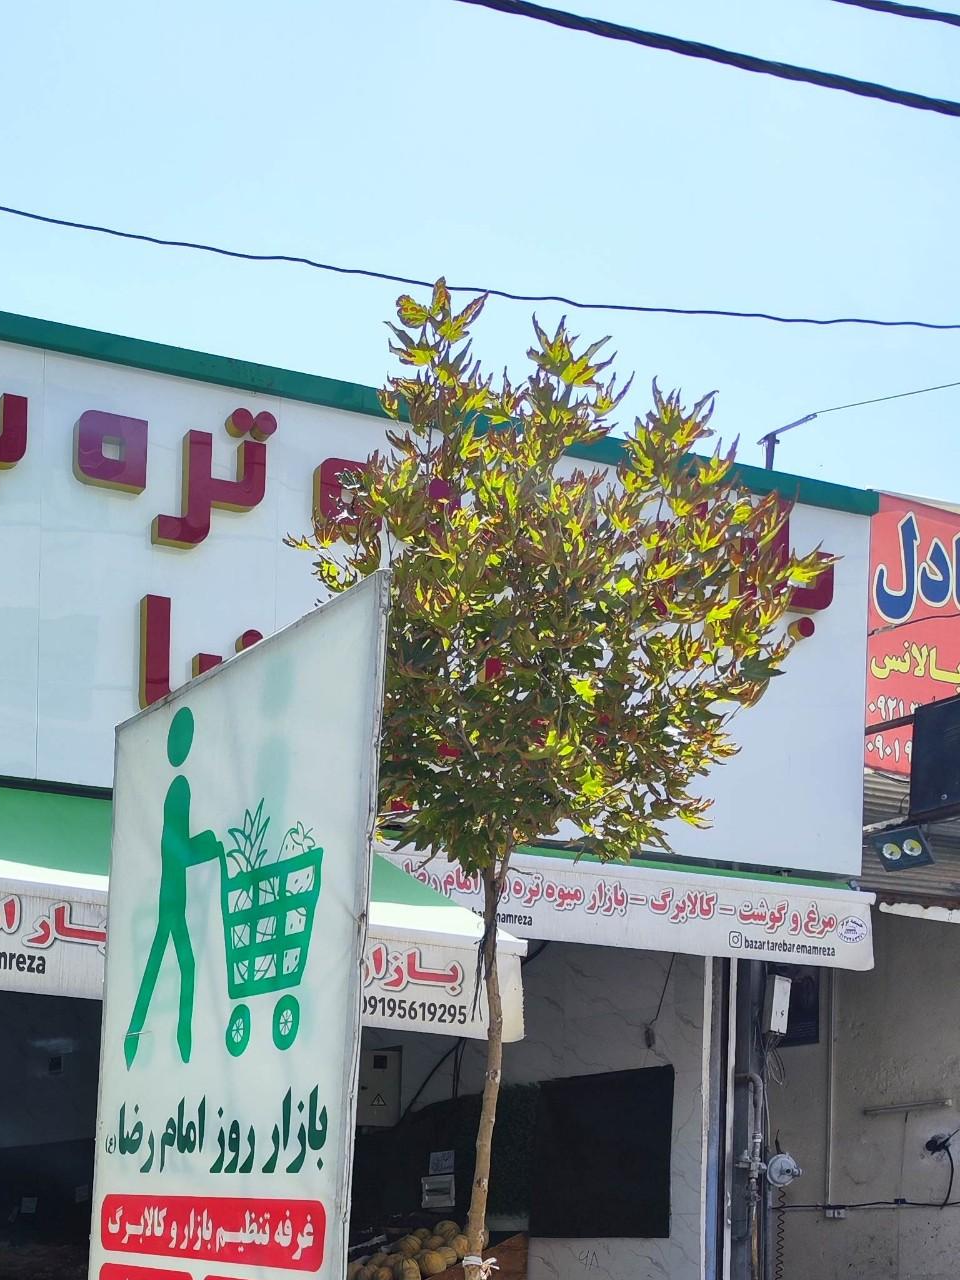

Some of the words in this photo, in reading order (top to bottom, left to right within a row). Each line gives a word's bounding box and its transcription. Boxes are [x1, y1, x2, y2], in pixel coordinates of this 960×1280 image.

[73, 407, 277, 550] تره
[513, 873, 544, 908] تره
[544, 880, 584, 912] میوه
[585, 878, 629, 917] بازار
[650, 886, 717, 925] کالابرگ
[736, 898, 788, 934] گوشت
[788, 909, 803, 936] و
[801, 901, 838, 938] مرغ
[118, 1101, 156, 1174] رضا
[159, 1094, 207, 1174] امام
[209, 1106, 257, 1174] روز
[262, 1084, 329, 1174] بازار
[108, 1206, 168, 1245] کالابرگ
[168, 1220, 178, 1249] و
[180, 1207, 213, 1251] بازار
[216, 1210, 271, 1253] تنظیم
[274, 1210, 315, 1261] غرفه
